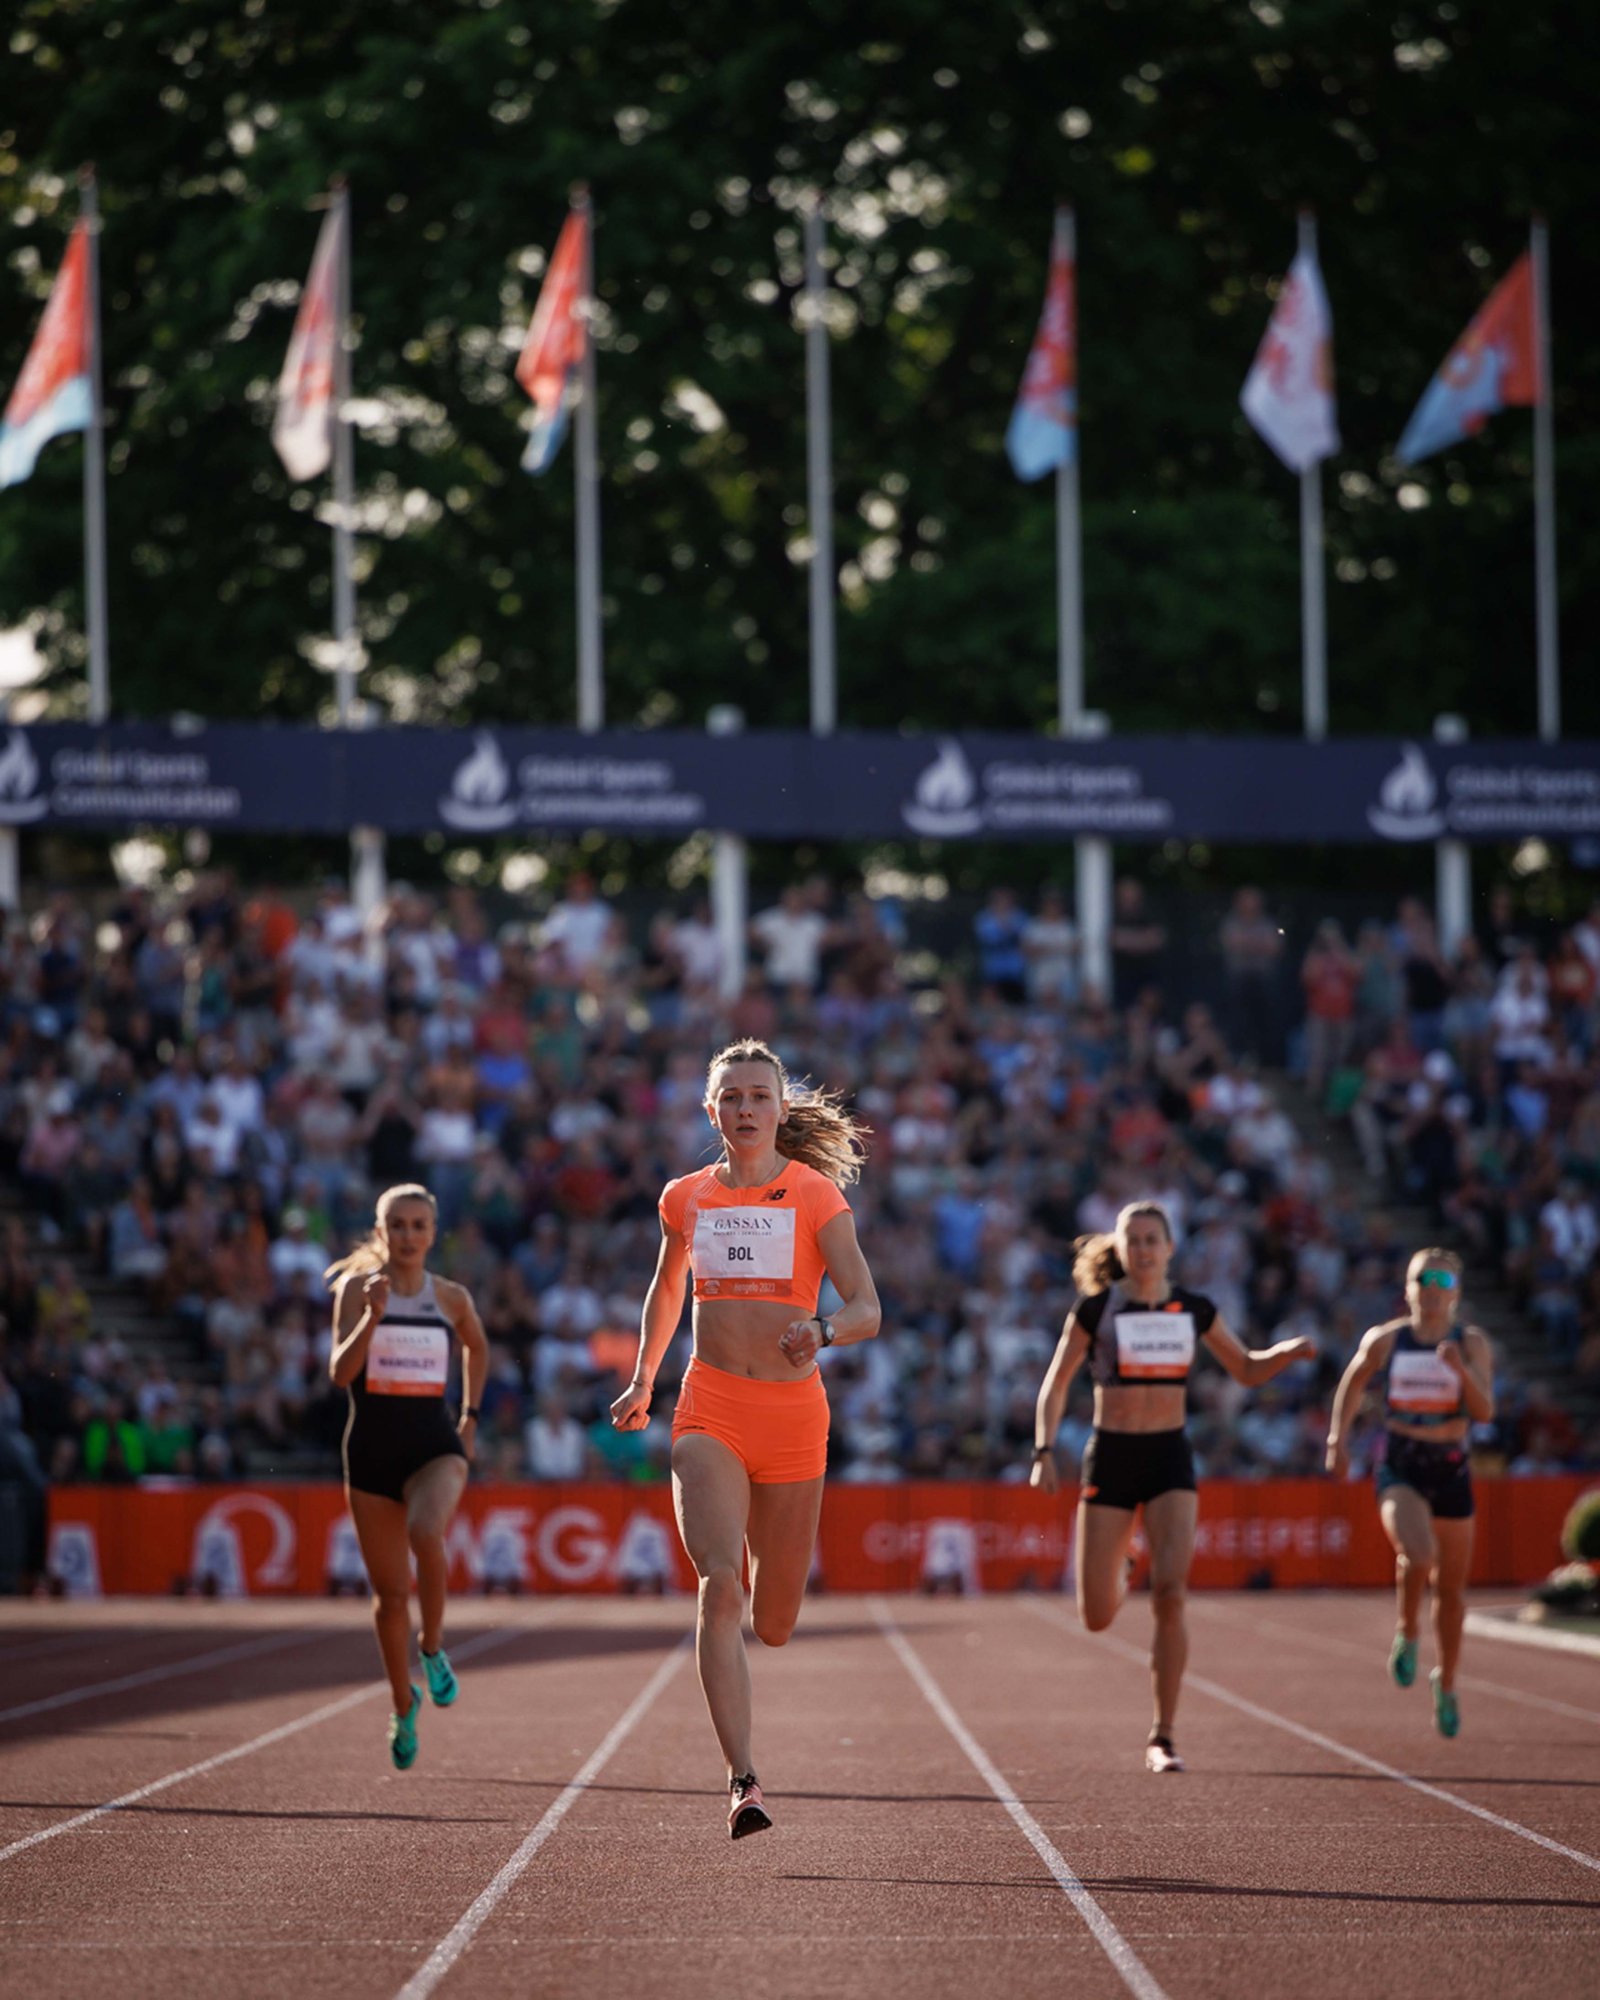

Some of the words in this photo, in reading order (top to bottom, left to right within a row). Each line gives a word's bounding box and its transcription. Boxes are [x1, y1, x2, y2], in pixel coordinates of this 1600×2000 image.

[714, 1217, 772, 1230] GASSAN
[728, 1247, 754, 1260] BOL
[863, 1521, 1063, 1563] OFCIAL
